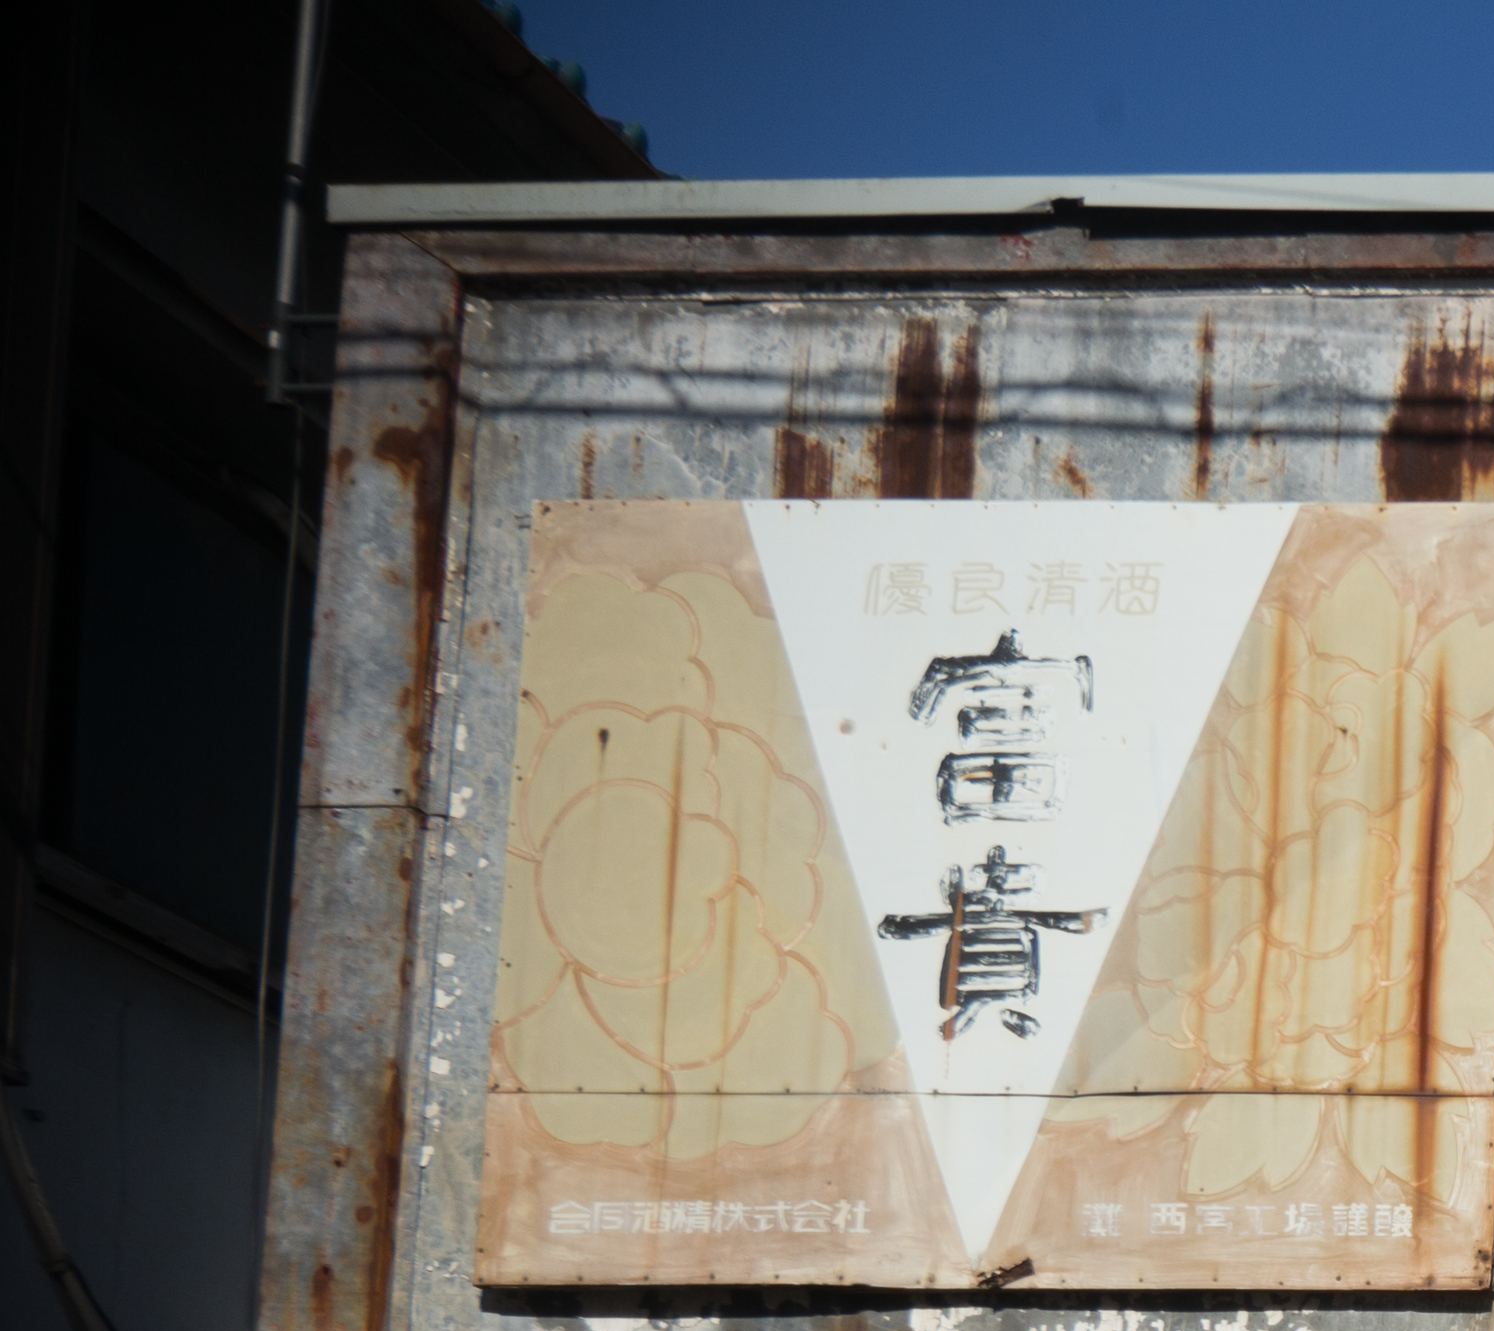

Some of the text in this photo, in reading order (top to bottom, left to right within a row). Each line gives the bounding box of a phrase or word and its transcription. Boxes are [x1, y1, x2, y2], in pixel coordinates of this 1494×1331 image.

[863, 559, 1164, 619] 優良清酒
[876, 627, 1110, 1042] 富貴
